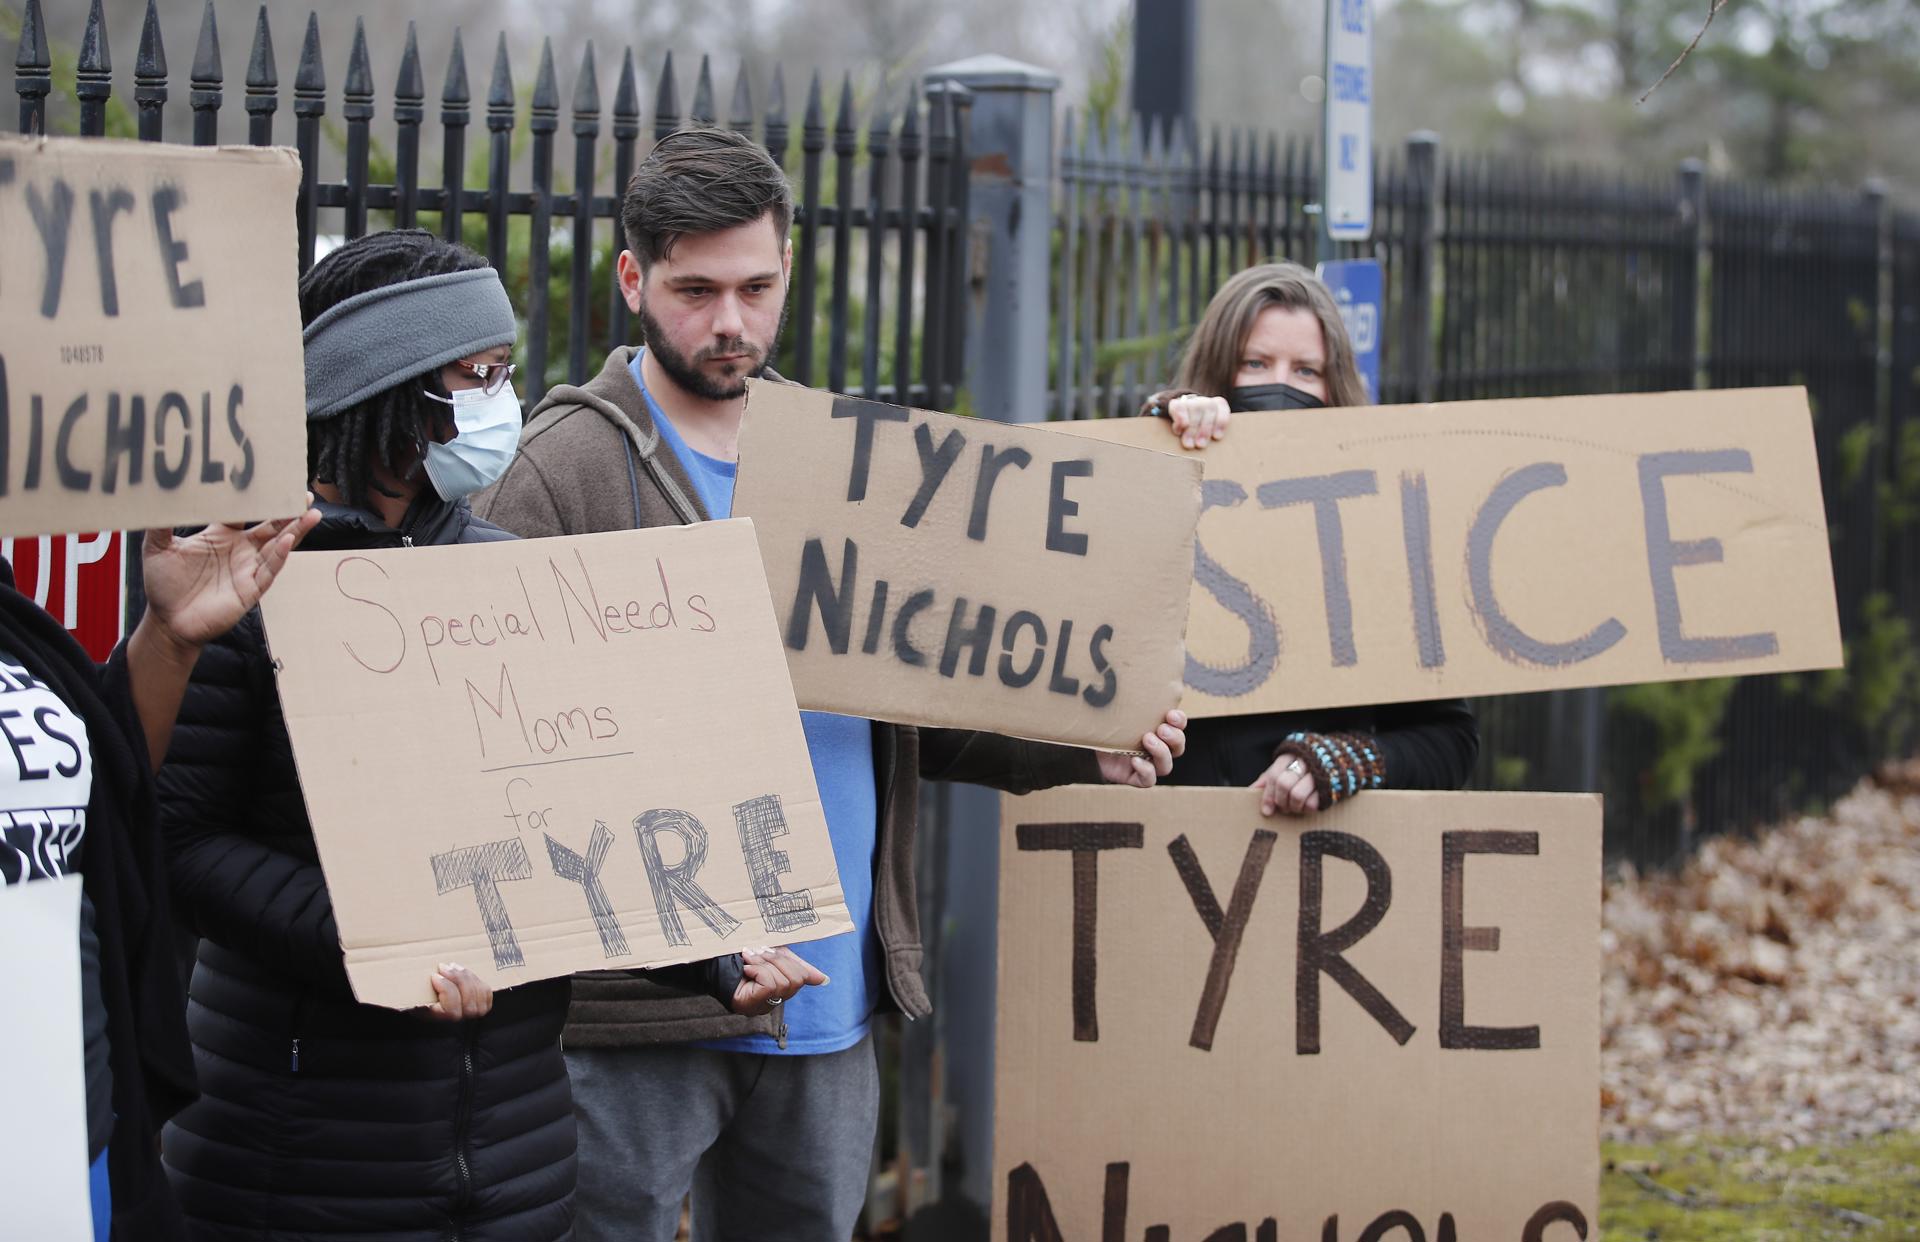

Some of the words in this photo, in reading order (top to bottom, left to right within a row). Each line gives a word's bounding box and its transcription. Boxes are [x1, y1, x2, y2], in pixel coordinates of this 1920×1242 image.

[0, 350, 255, 497] ICHOLS
[335, 556, 545, 686] Special
[549, 547, 717, 643] Needs
[786, 537, 1117, 708] NICHOLS
[464, 663, 619, 758] Moms
[504, 777, 554, 832] for
[430, 793, 820, 971] TYRE
[1015, 822, 1541, 1055] TYRE
